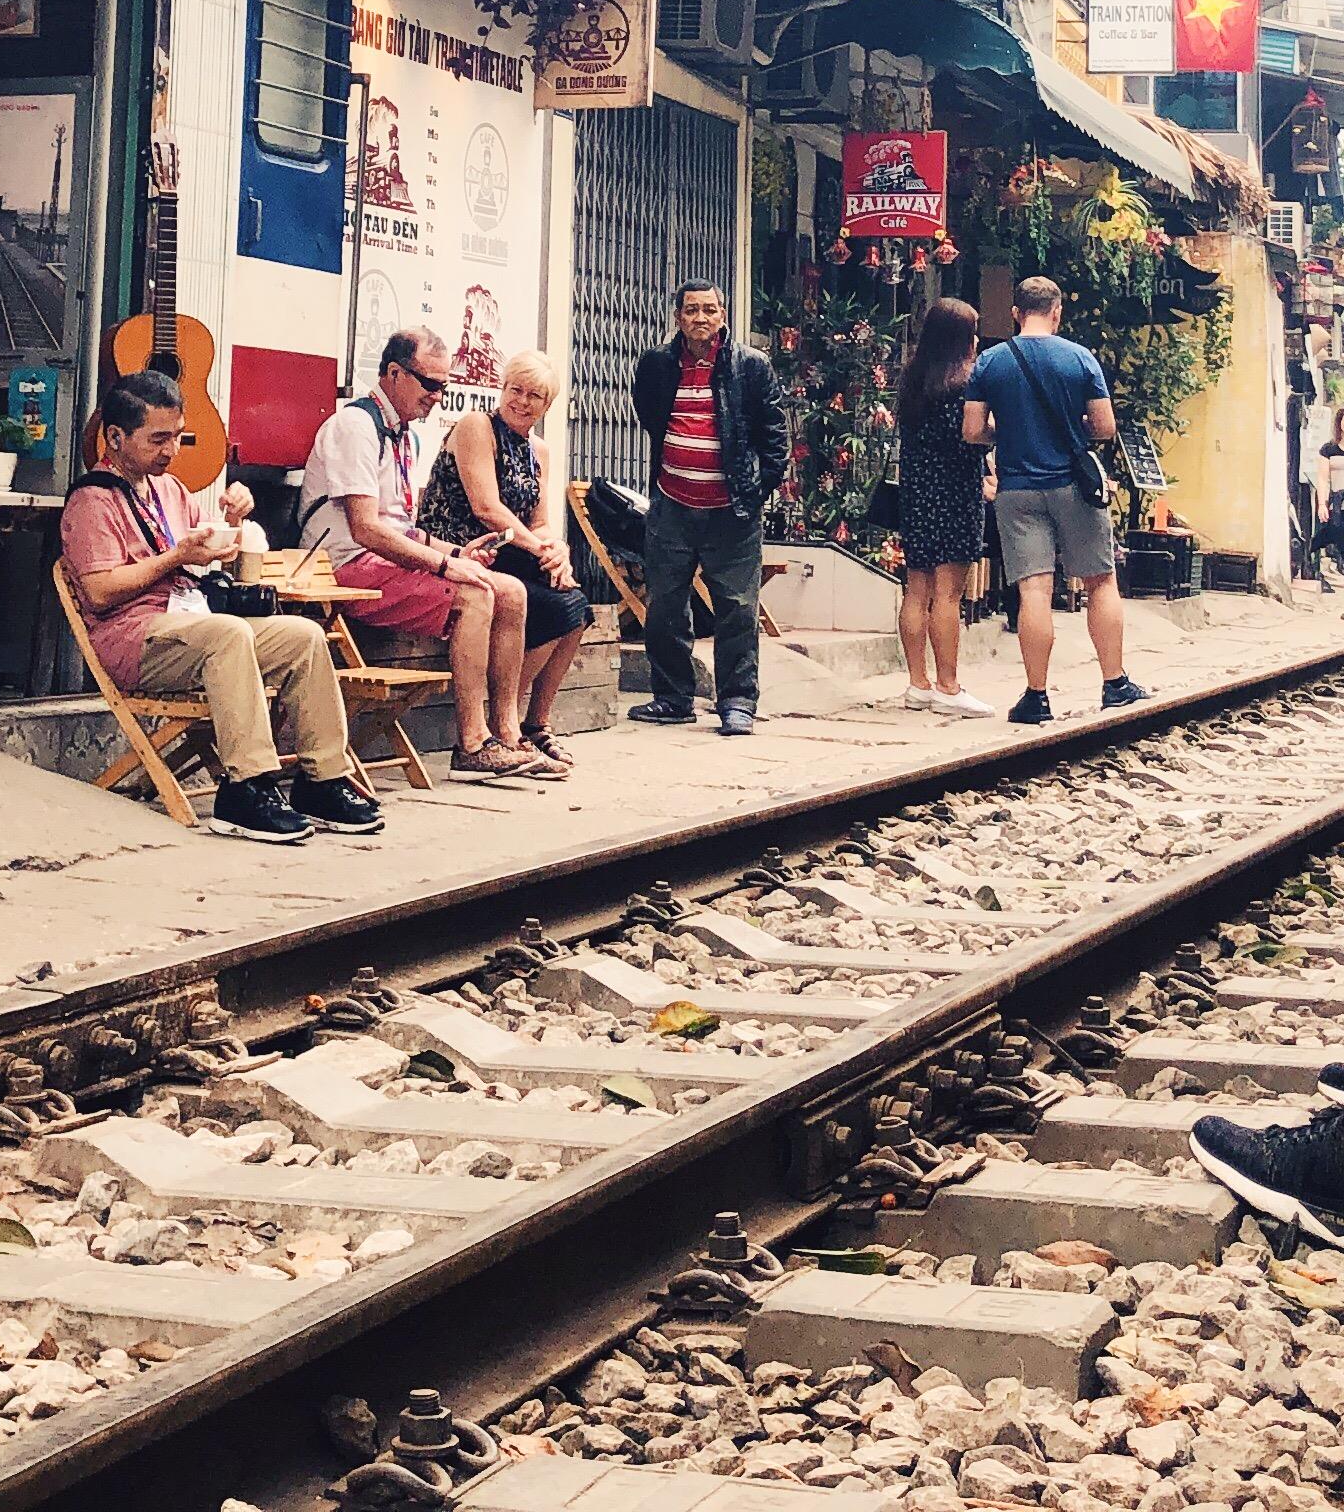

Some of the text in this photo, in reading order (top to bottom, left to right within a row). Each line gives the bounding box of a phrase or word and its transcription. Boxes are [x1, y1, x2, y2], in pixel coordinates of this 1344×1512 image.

[1090, 4, 1172, 23] TRAIN STATION
[385, 13, 408, 57] GIỜ
[1098, 29, 1128, 40] Coffee
[1140, 29, 1158, 40] Bar
[845, 196, 941, 217] RAILWAY
[880, 216, 908, 228] Café
[362, 232, 394, 250] Arrival
[396, 239, 418, 255] Time
